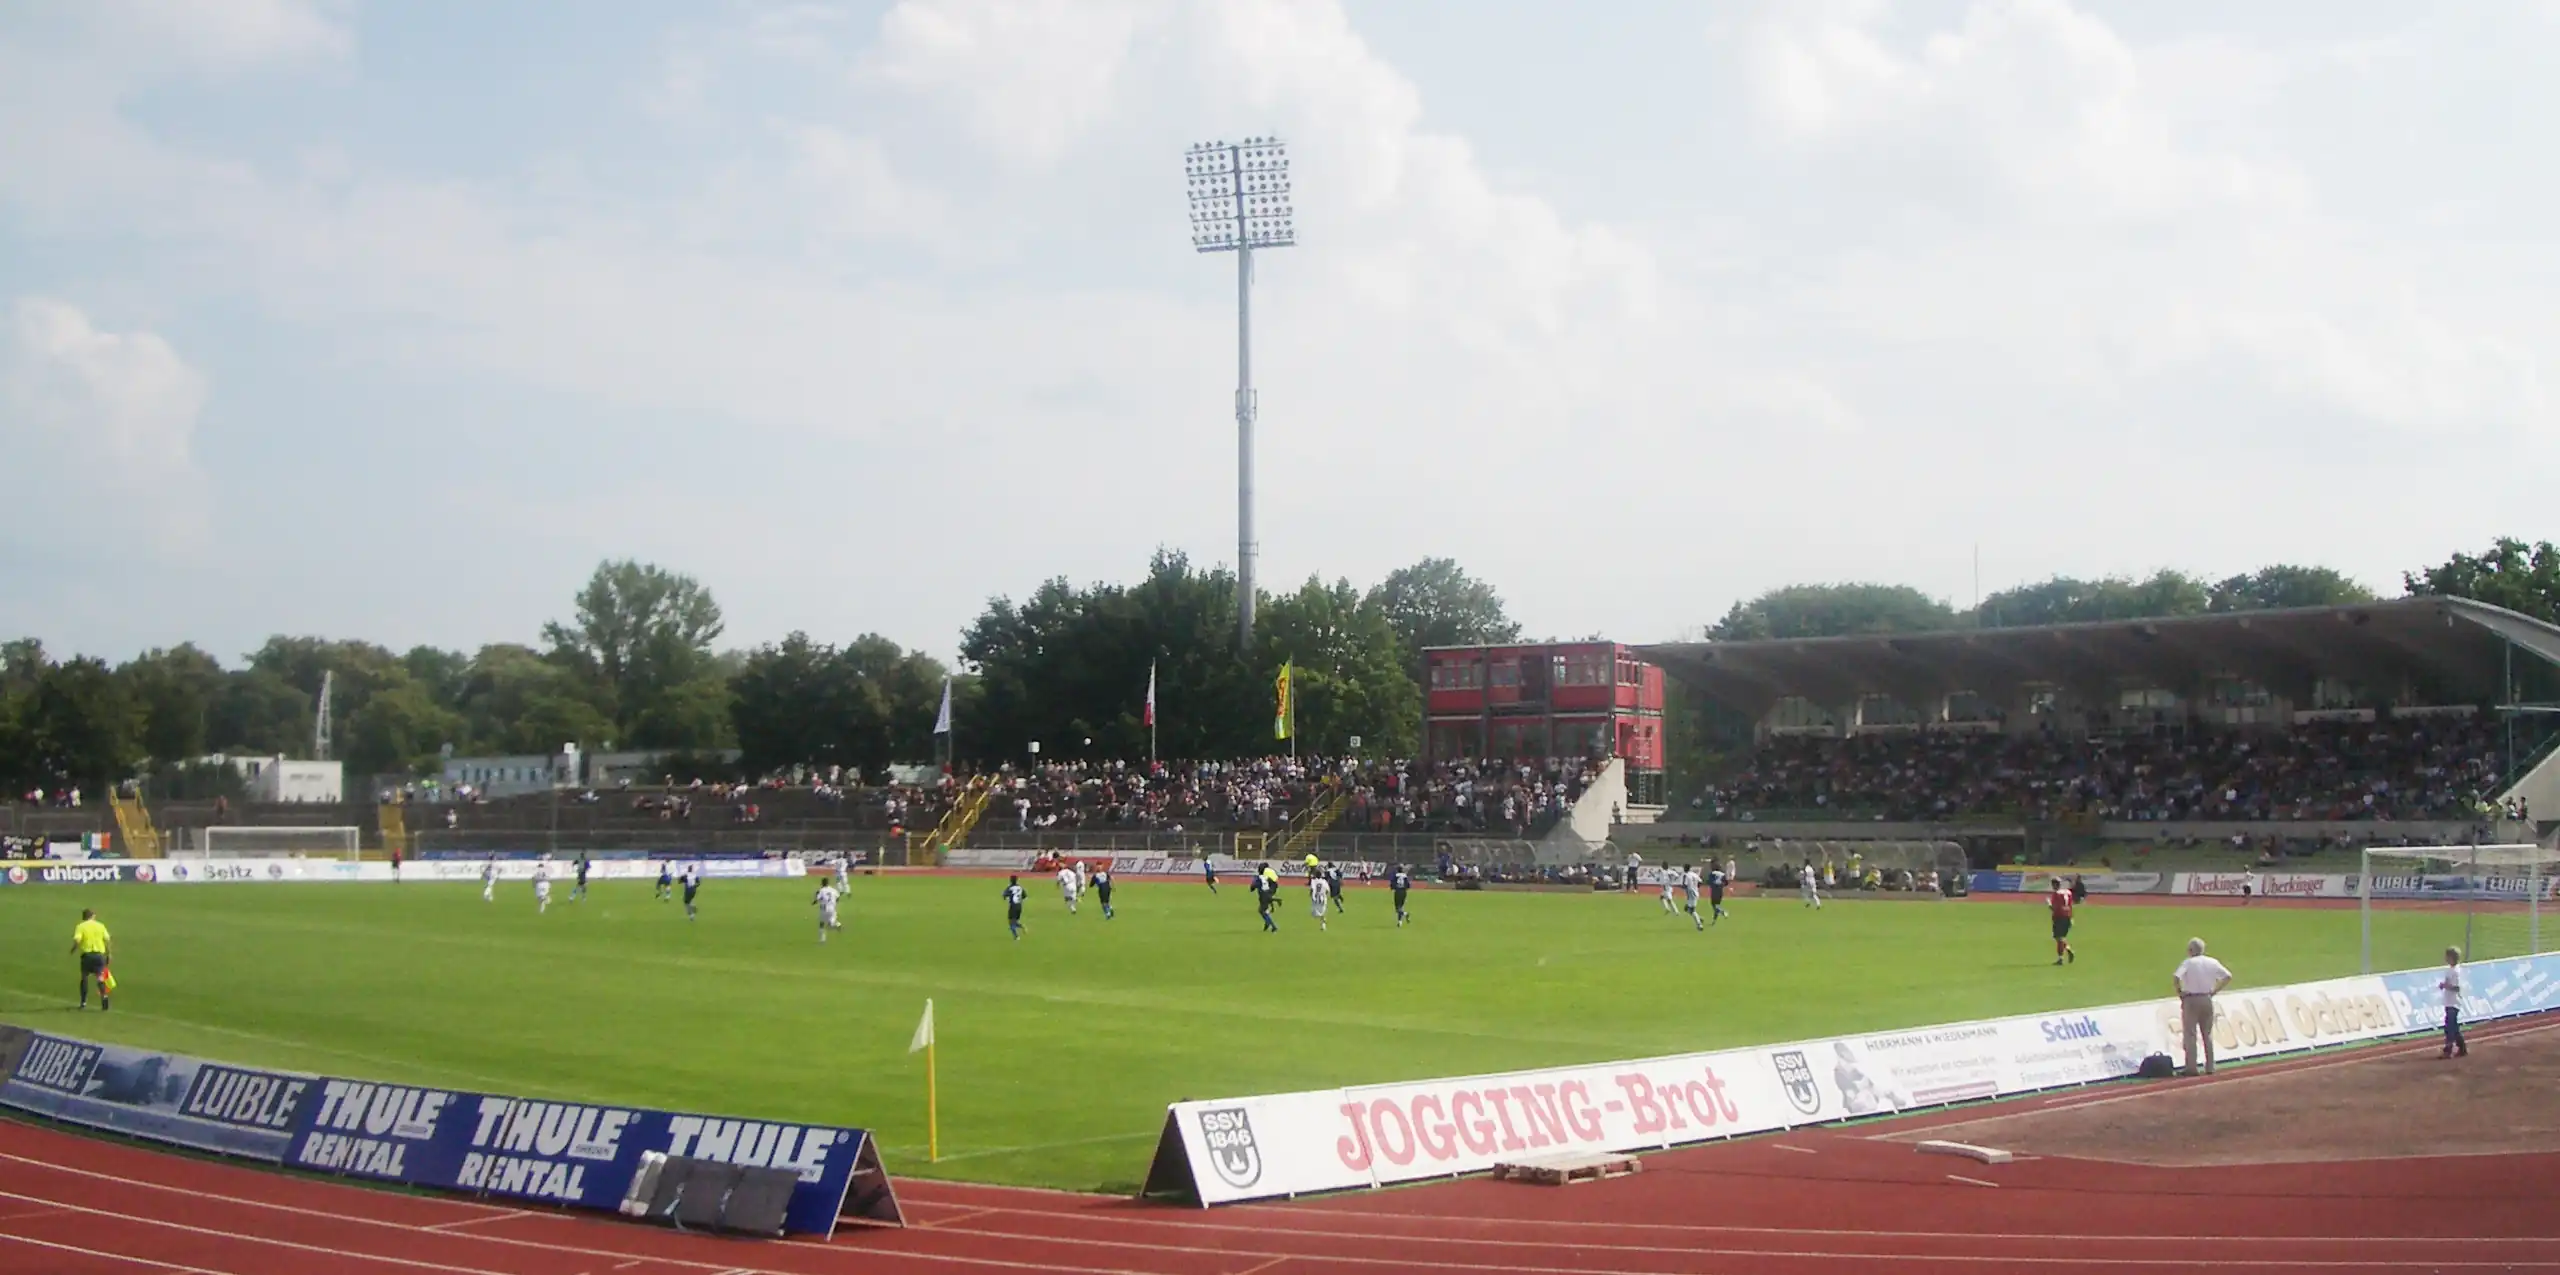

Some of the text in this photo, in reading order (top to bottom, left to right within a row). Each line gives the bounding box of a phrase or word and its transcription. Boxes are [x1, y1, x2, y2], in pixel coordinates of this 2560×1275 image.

[43, 864, 121, 883] uhlsport
[203, 863, 253, 879] Seitz
[1865, 1036, 1923, 1052] HERRMANN
[1933, 1026, 1998, 1044] WIEDENMANN
[2040, 1015, 2102, 1043] Schuk
[2211, 990, 2396, 1049] Gold Ochsen
[17, 1037, 95, 1090] LUIBLE
[1775, 1053, 1804, 1070] SSV
[1781, 1068, 1810, 1084] 1846
[188, 1069, 306, 1128] LUIBLE
[315, 1080, 448, 1139] THULE
[1204, 1112, 1245, 1131] SSV
[1337, 1066, 1738, 1171] JOGGING-Brot
[471, 1097, 630, 1160] THULE
[667, 1115, 837, 1182] THULE
[1207, 1129, 1251, 1149] 1846
[299, 1131, 406, 1177] RENTAL
[456, 1152, 585, 1200] RENTAL
